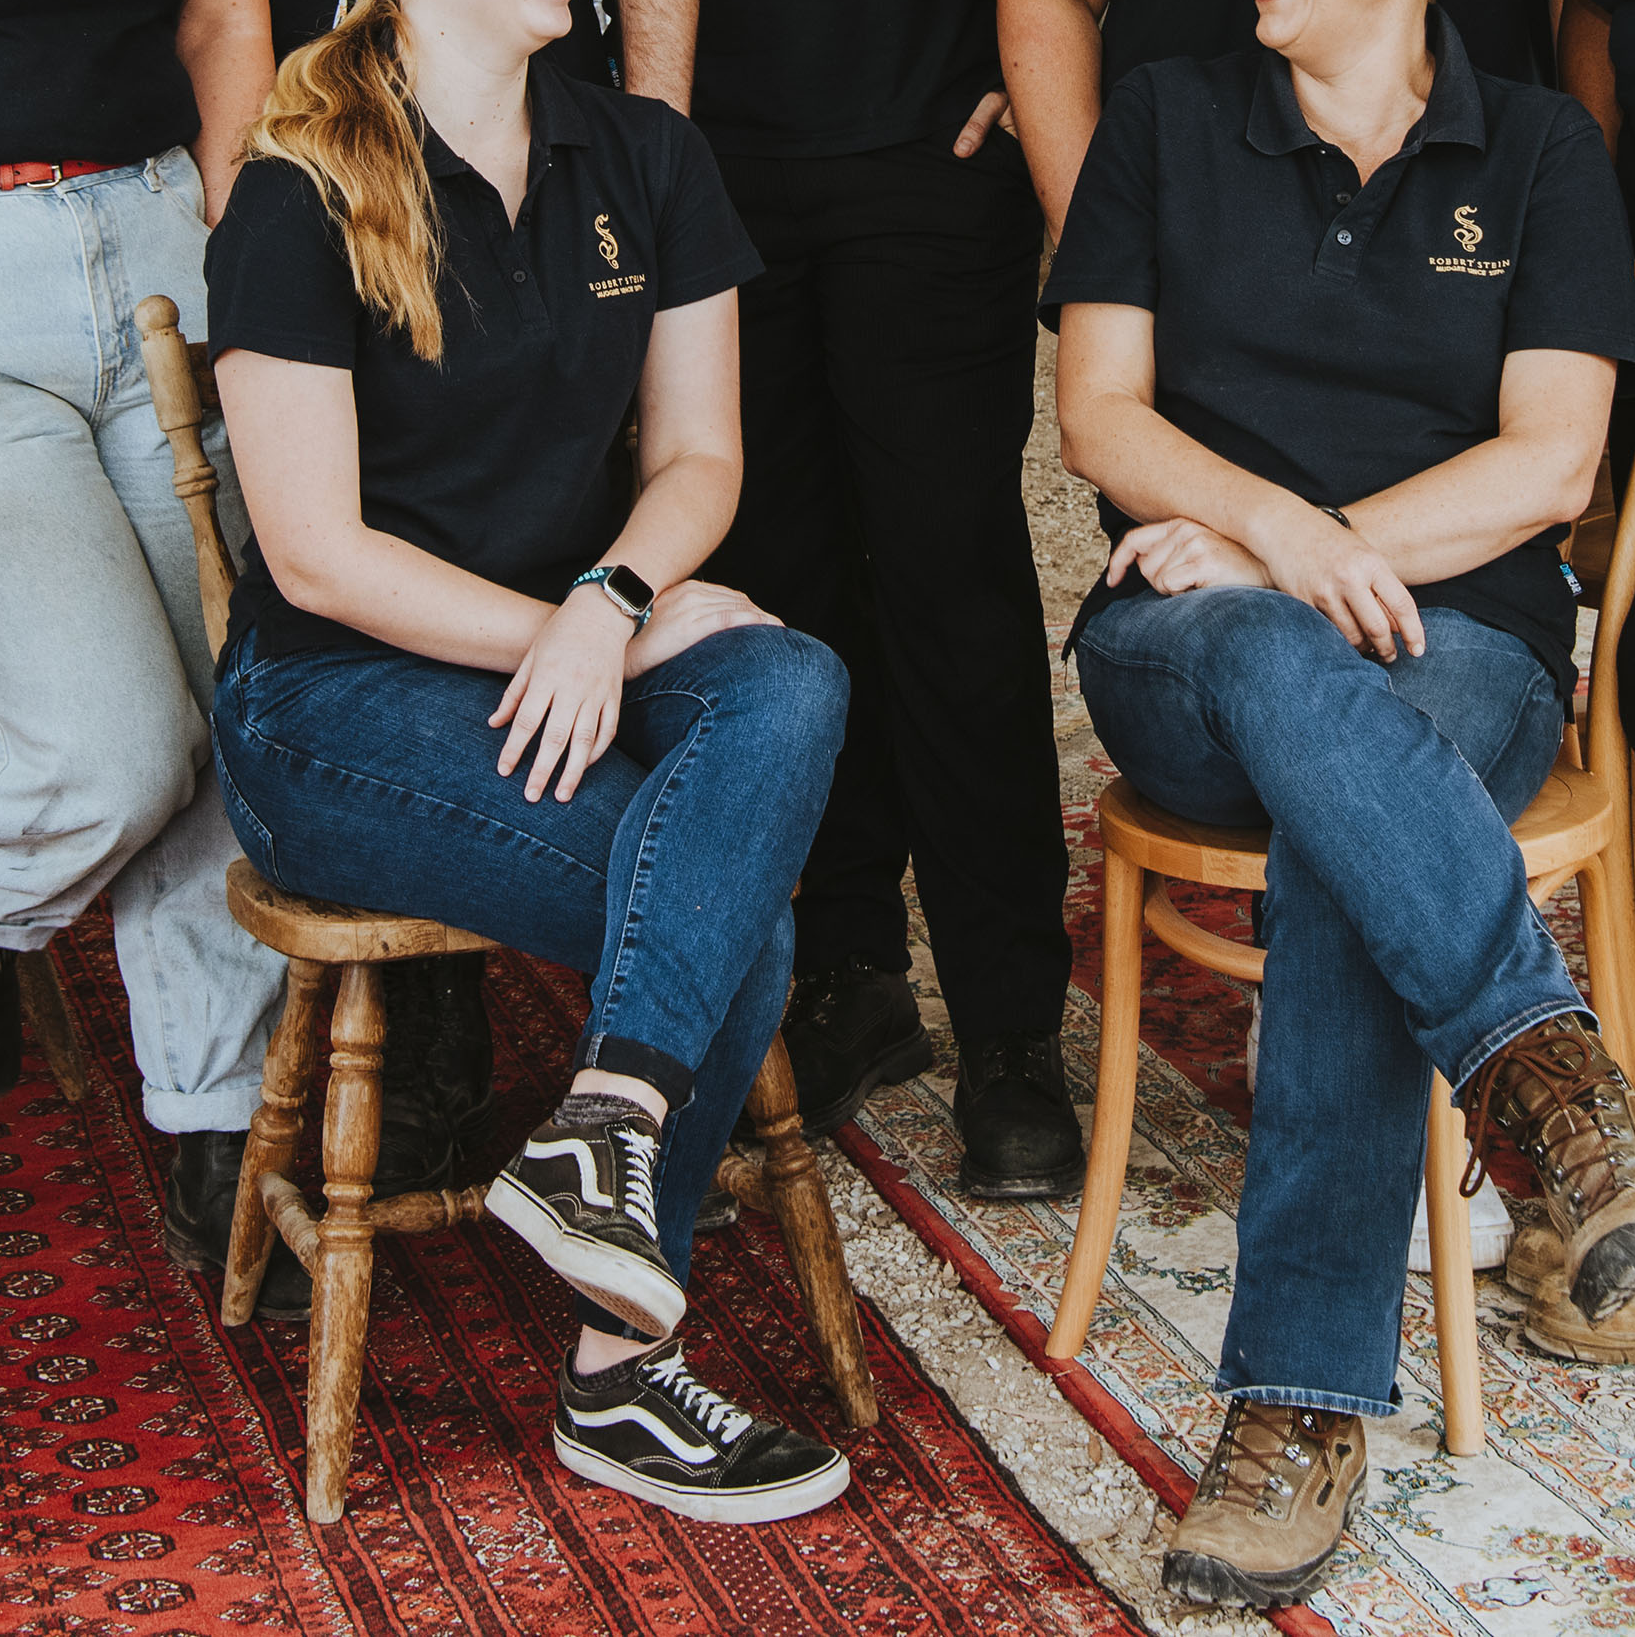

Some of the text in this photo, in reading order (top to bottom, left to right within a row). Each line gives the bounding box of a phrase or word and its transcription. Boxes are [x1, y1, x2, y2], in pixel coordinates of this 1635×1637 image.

[1428, 257, 1511, 269] ROBERT STEIN
[588, 273, 646, 292] ROBERT STEIN
